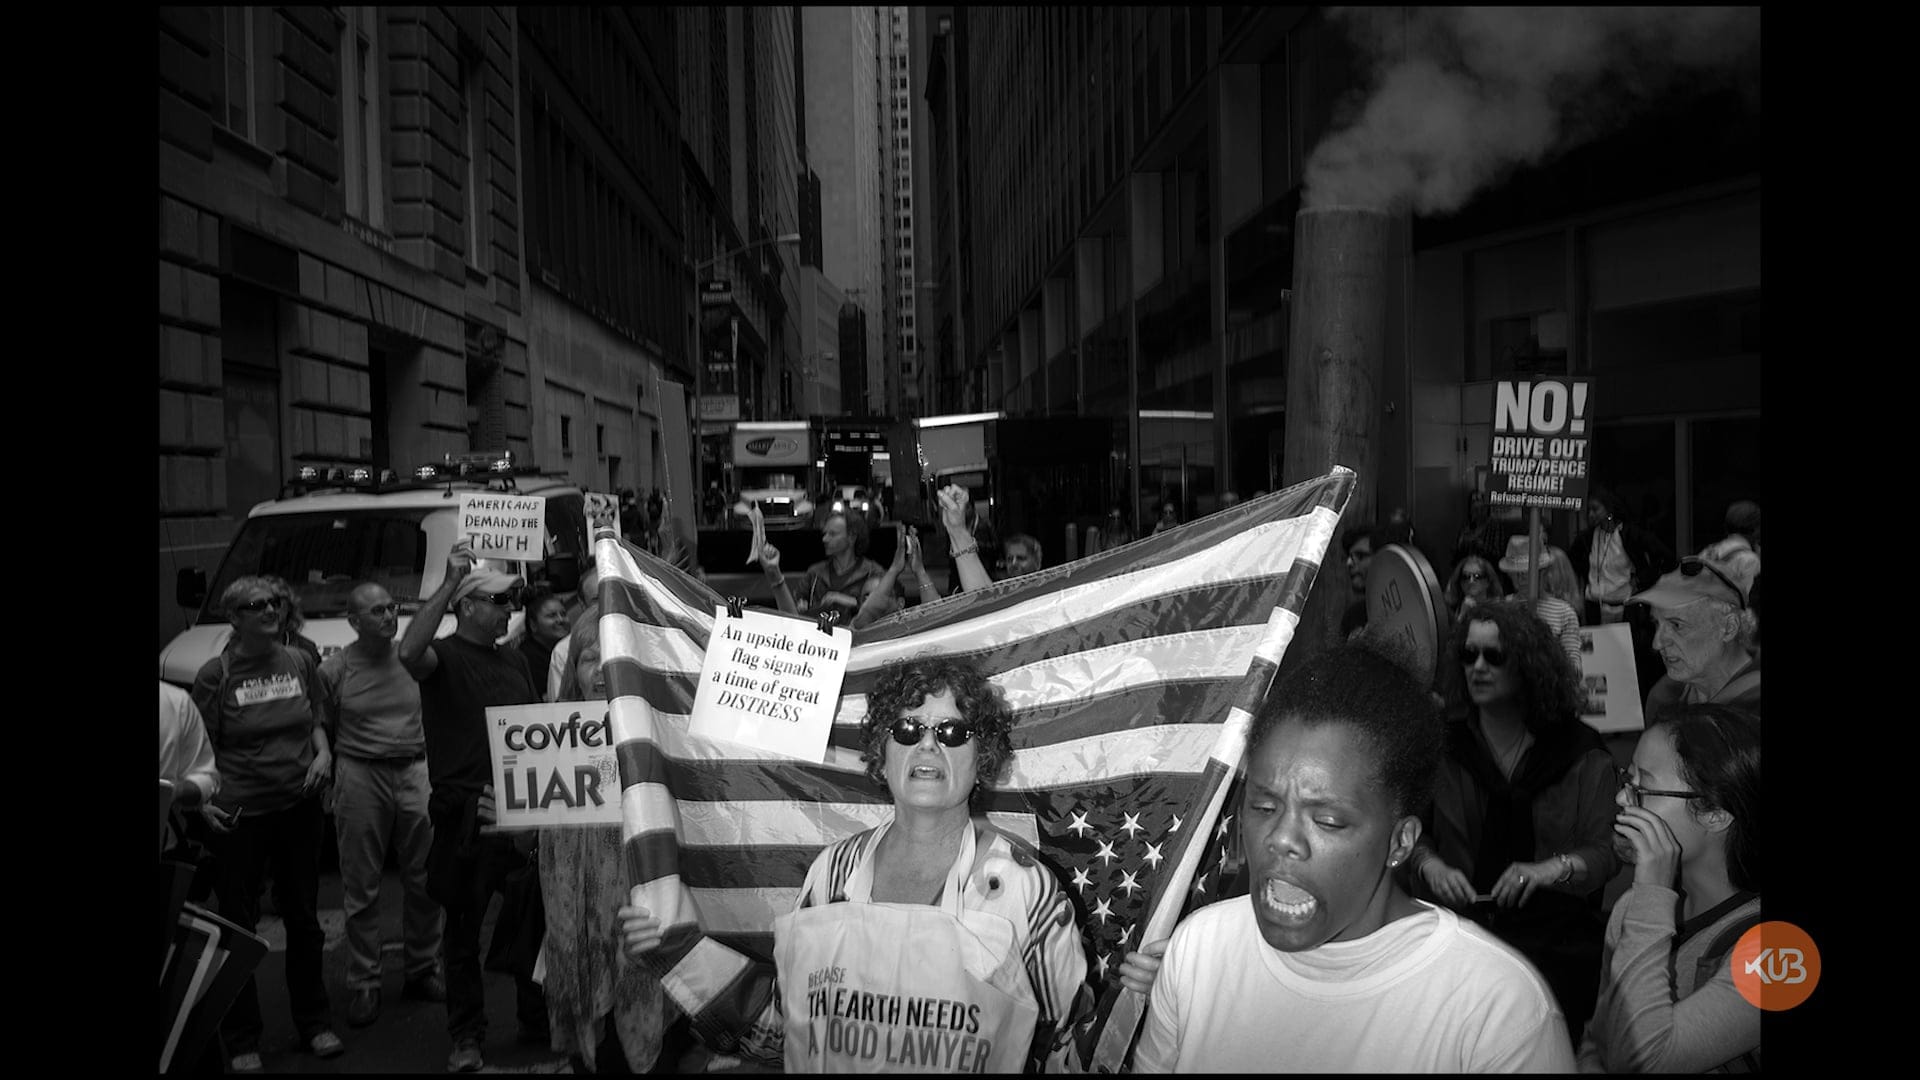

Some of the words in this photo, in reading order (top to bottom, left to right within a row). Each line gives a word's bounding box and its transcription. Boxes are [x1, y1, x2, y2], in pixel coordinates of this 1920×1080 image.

[1494, 380, 1588, 435] NO!
[1492, 436, 1545, 458] DRIVE
[1549, 438, 1588, 460] OUT
[1491, 457, 1586, 478] TRUMP/PENCE
[1508, 474, 1564, 493] REGIME!
[467, 498, 540, 510] AMERICANS
[1490, 490, 1582, 509] RefuseFascism.org
[465, 514, 519, 528] DEMAND
[521, 518, 539, 528] THE
[466, 532, 528, 551] TRUTH
[720, 623, 743, 642] An
[745, 632, 794, 652] upside
[797, 639, 839, 661] down
[731, 646, 761, 670] flag
[762, 655, 814, 678] signals
[712, 670, 722, 683] a
[724, 670, 758, 690] time
[761, 680, 780, 694] of
[778, 684, 820, 704] great
[716, 690, 803, 723] DISTRESS
[504, 765, 605, 810] LIAR
[808, 987, 827, 1018] TH
[834, 987, 901, 1026] EARTH
[906, 996, 981, 1034] NEEDS
[808, 1020, 819, 1057] A
[829, 1017, 878, 1060] OOD
[886, 1027, 992, 1073] LAWYER
